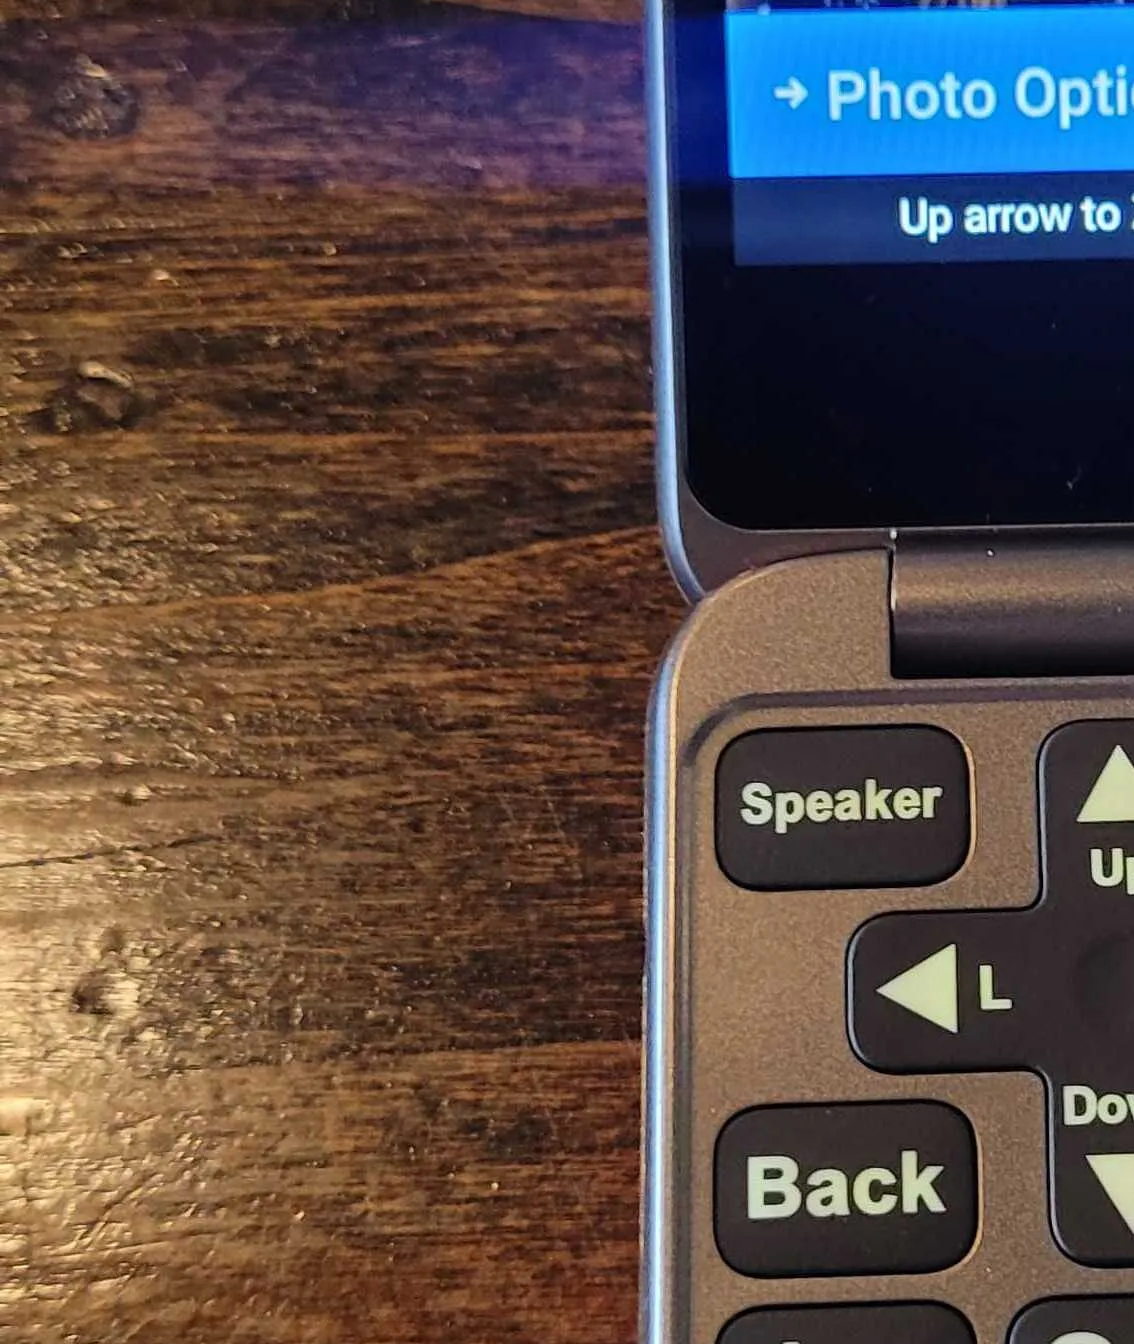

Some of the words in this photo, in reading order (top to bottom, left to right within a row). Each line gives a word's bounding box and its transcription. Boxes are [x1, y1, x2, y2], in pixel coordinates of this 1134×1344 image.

[829, 68, 996, 120] Photo
[900, 198, 953, 243] Up
[964, 203, 1073, 234] arrow
[1080, 197, 1121, 232] to
[741, 779, 942, 833] Speaker
[980, 965, 1012, 1010] L
[748, 1151, 946, 1219] Back
